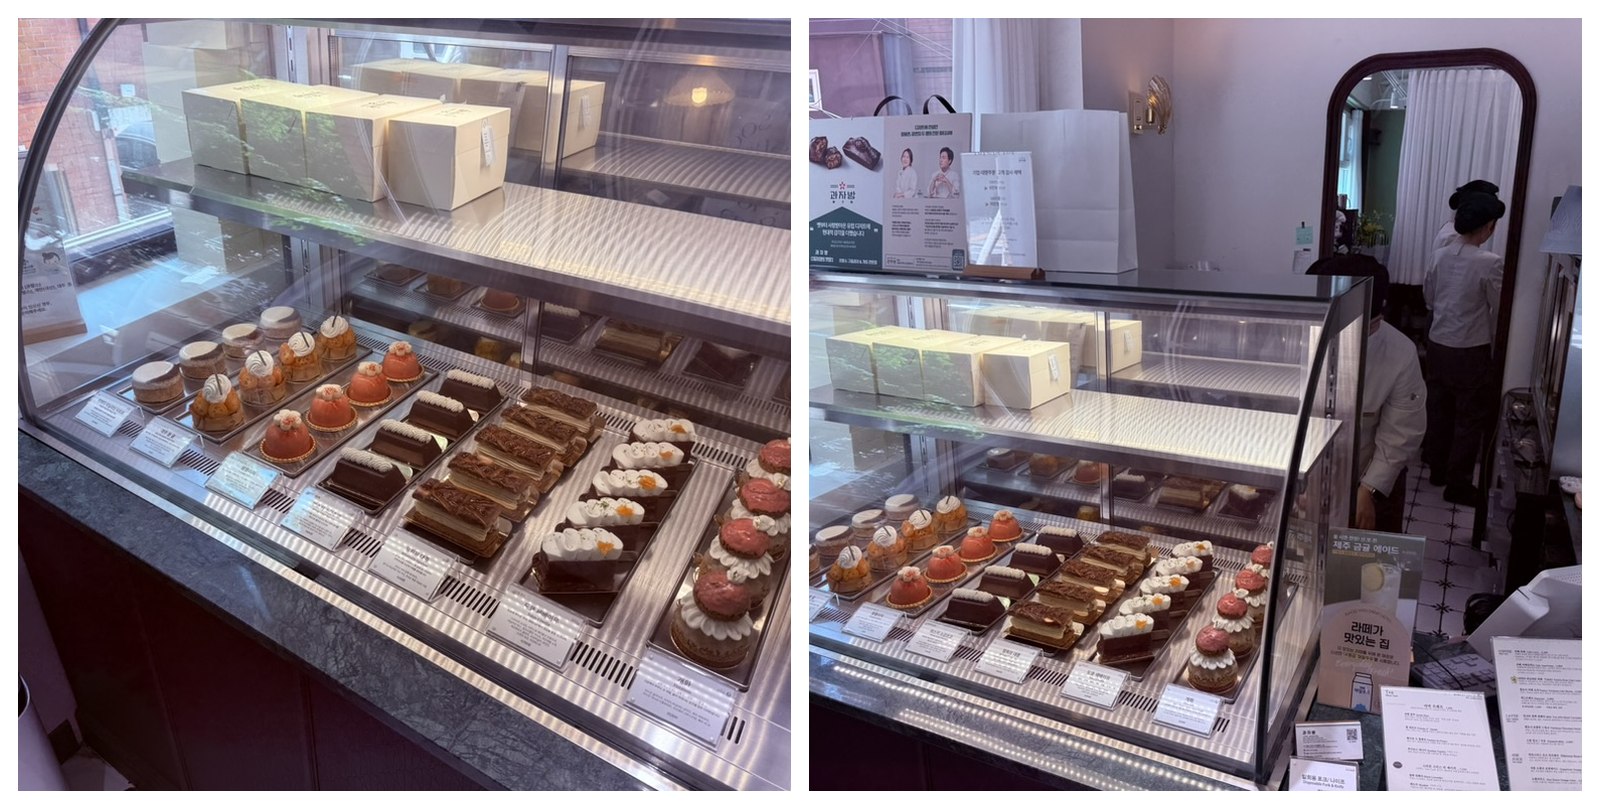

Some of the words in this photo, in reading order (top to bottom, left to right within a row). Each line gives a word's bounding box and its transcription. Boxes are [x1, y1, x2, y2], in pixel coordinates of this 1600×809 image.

[830, 190, 857, 200] 과자방
[1332, 541, 1350, 550] 제주
[1373, 545, 1400, 555] 에이드
[1351, 621, 1384, 637] 라떼가
[1344, 632, 1376, 648] 맛있는
[1379, 638, 1390, 650] 집
